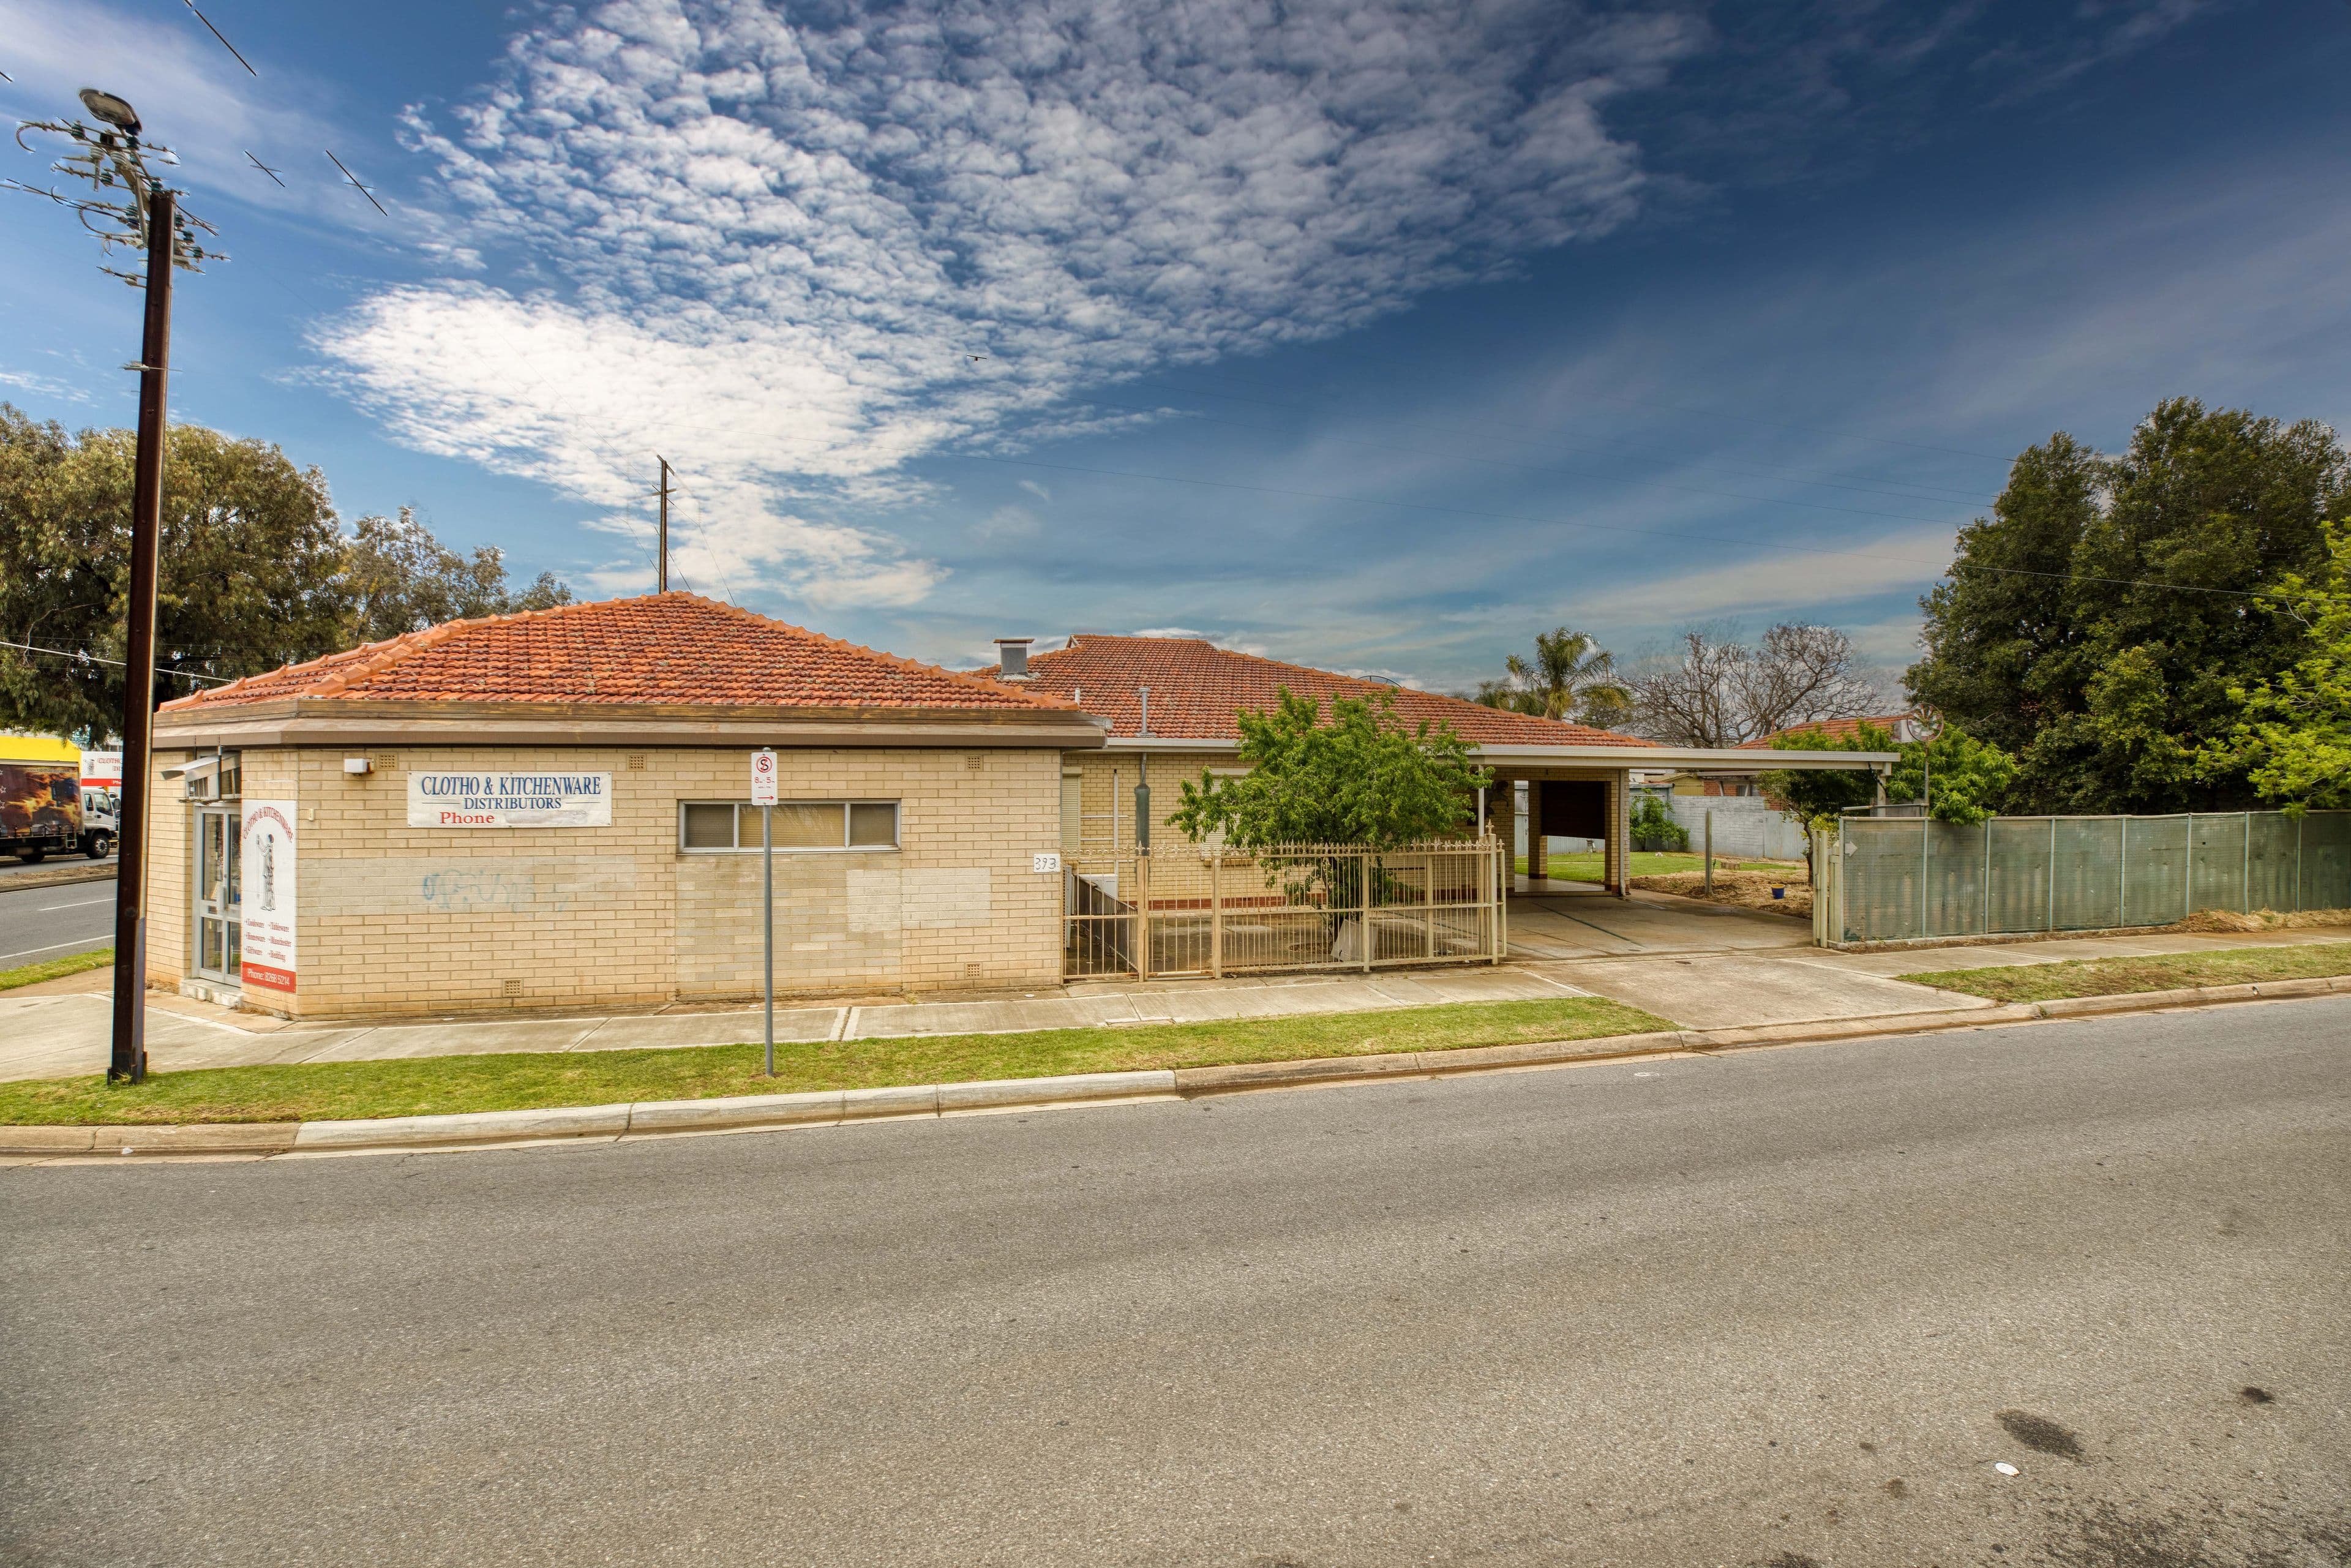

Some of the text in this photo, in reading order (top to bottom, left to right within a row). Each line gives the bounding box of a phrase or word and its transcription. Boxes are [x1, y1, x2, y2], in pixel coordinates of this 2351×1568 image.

[421, 776, 601, 795] CLOTHO & KITCHENWARE
[463, 797, 562, 810] DISTRIBUTORS
[263, 806, 294, 843] KITCHENWARE
[439, 811, 496, 825] Phone
[1035, 857, 1057, 870] 393
[247, 968, 264, 980] Phone:
